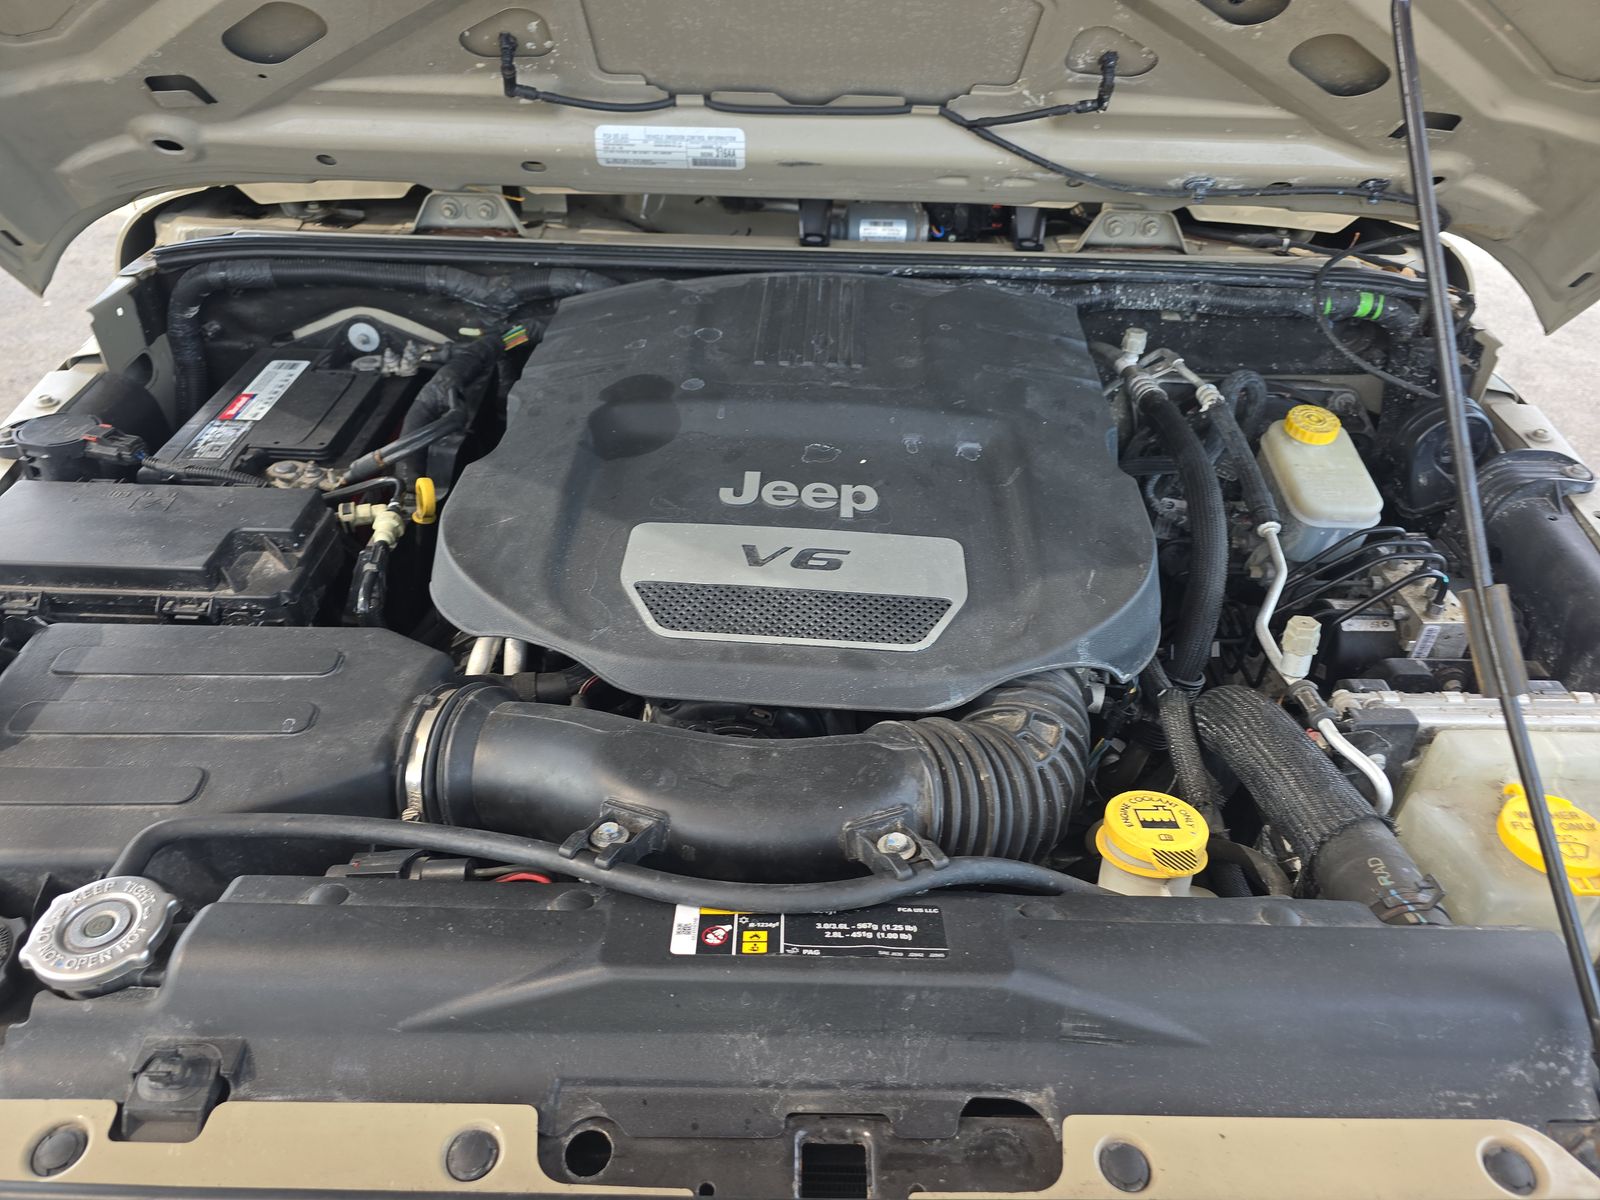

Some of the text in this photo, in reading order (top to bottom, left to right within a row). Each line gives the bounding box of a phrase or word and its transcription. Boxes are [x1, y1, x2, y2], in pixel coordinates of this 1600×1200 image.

[718, 470, 879, 519] Jeep
[741, 544, 851, 571] V6
[1120, 796, 1195, 828] ENGINE COOLANT ONLY
[1559, 822, 1597, 831] ONLY
[1368, 857, 1396, 886] RAD
[71, 880, 156, 908] KEEP TIGHT
[38, 924, 147, 970] DO NOT OPEN HOT
